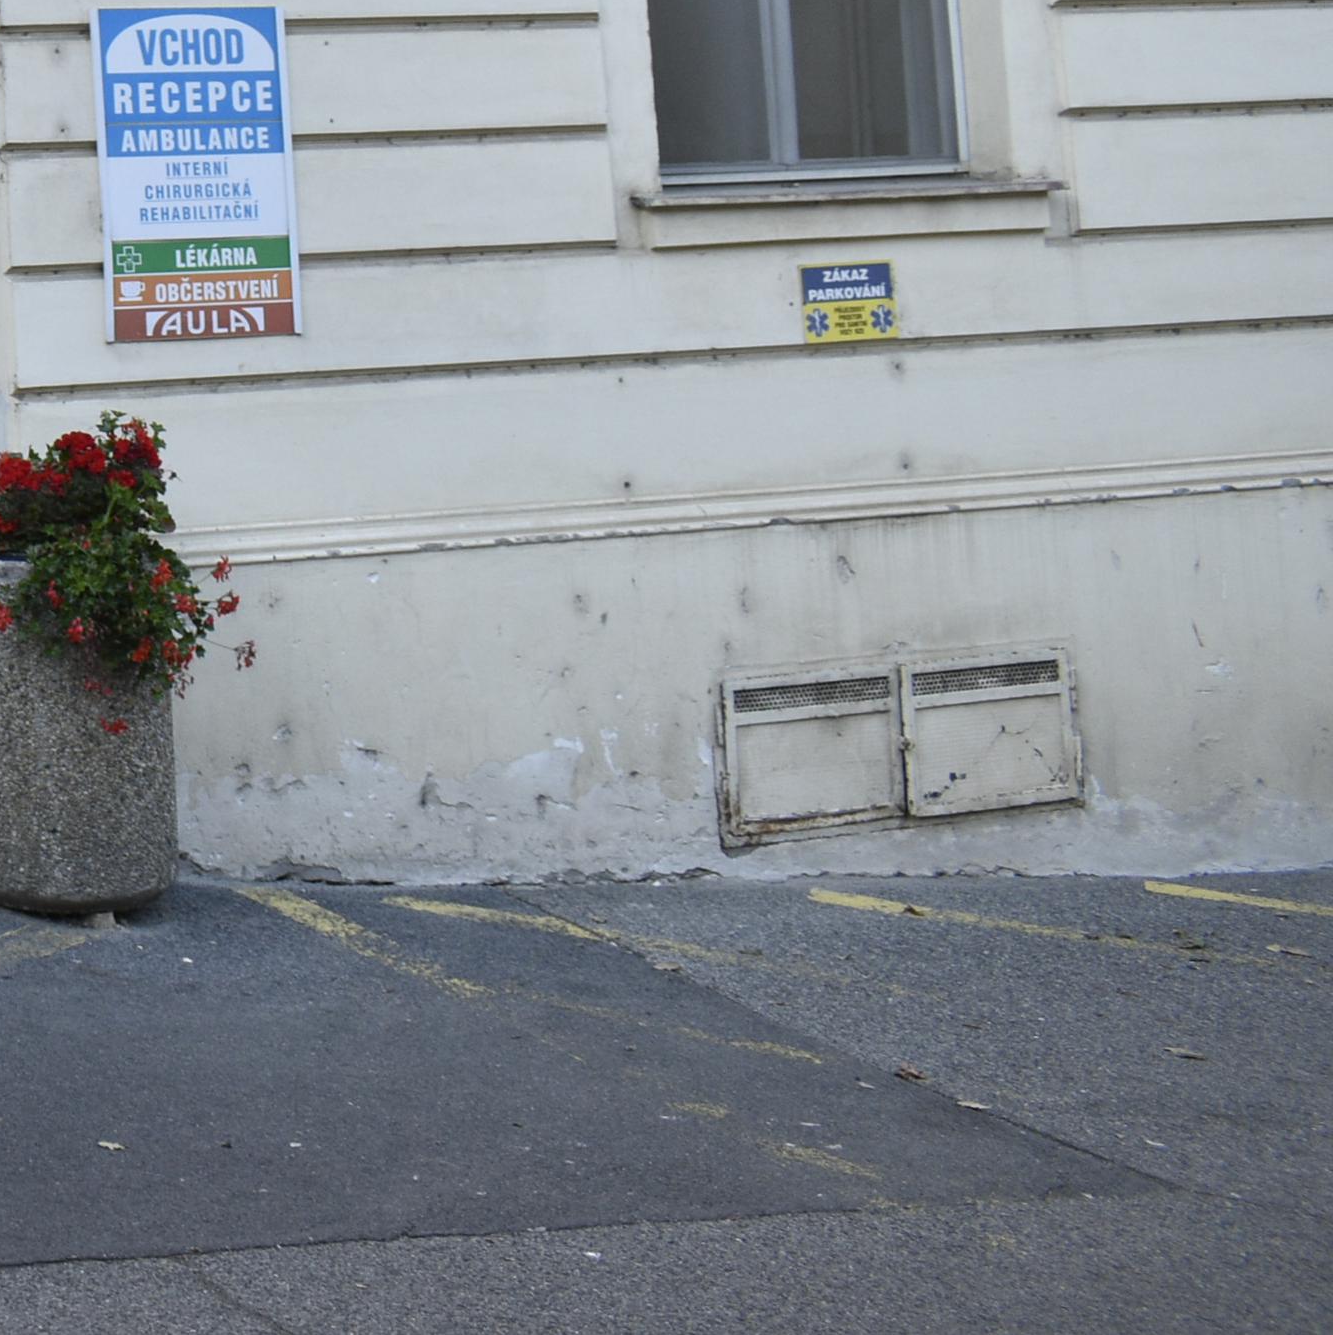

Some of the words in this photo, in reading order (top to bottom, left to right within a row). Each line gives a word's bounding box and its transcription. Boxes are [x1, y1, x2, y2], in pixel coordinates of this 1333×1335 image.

[136, 28, 244, 67] VCHOD
[113, 80, 273, 114] RECEPCE
[121, 127, 270, 153] AMBULANCE
[166, 157, 229, 177] INTERNÍ
[144, 178, 252, 200] CHIRURGICKÁ
[140, 201, 259, 222] REHABILITAČNÍ
[175, 244, 257, 268] LÉKÁRNA
[822, 267, 869, 282] ZÁKAZ
[155, 274, 279, 303] OBČERSTVENÍ
[808, 282, 886, 301] PARKOVÁNÍ
[161, 309, 251, 336] AULA
